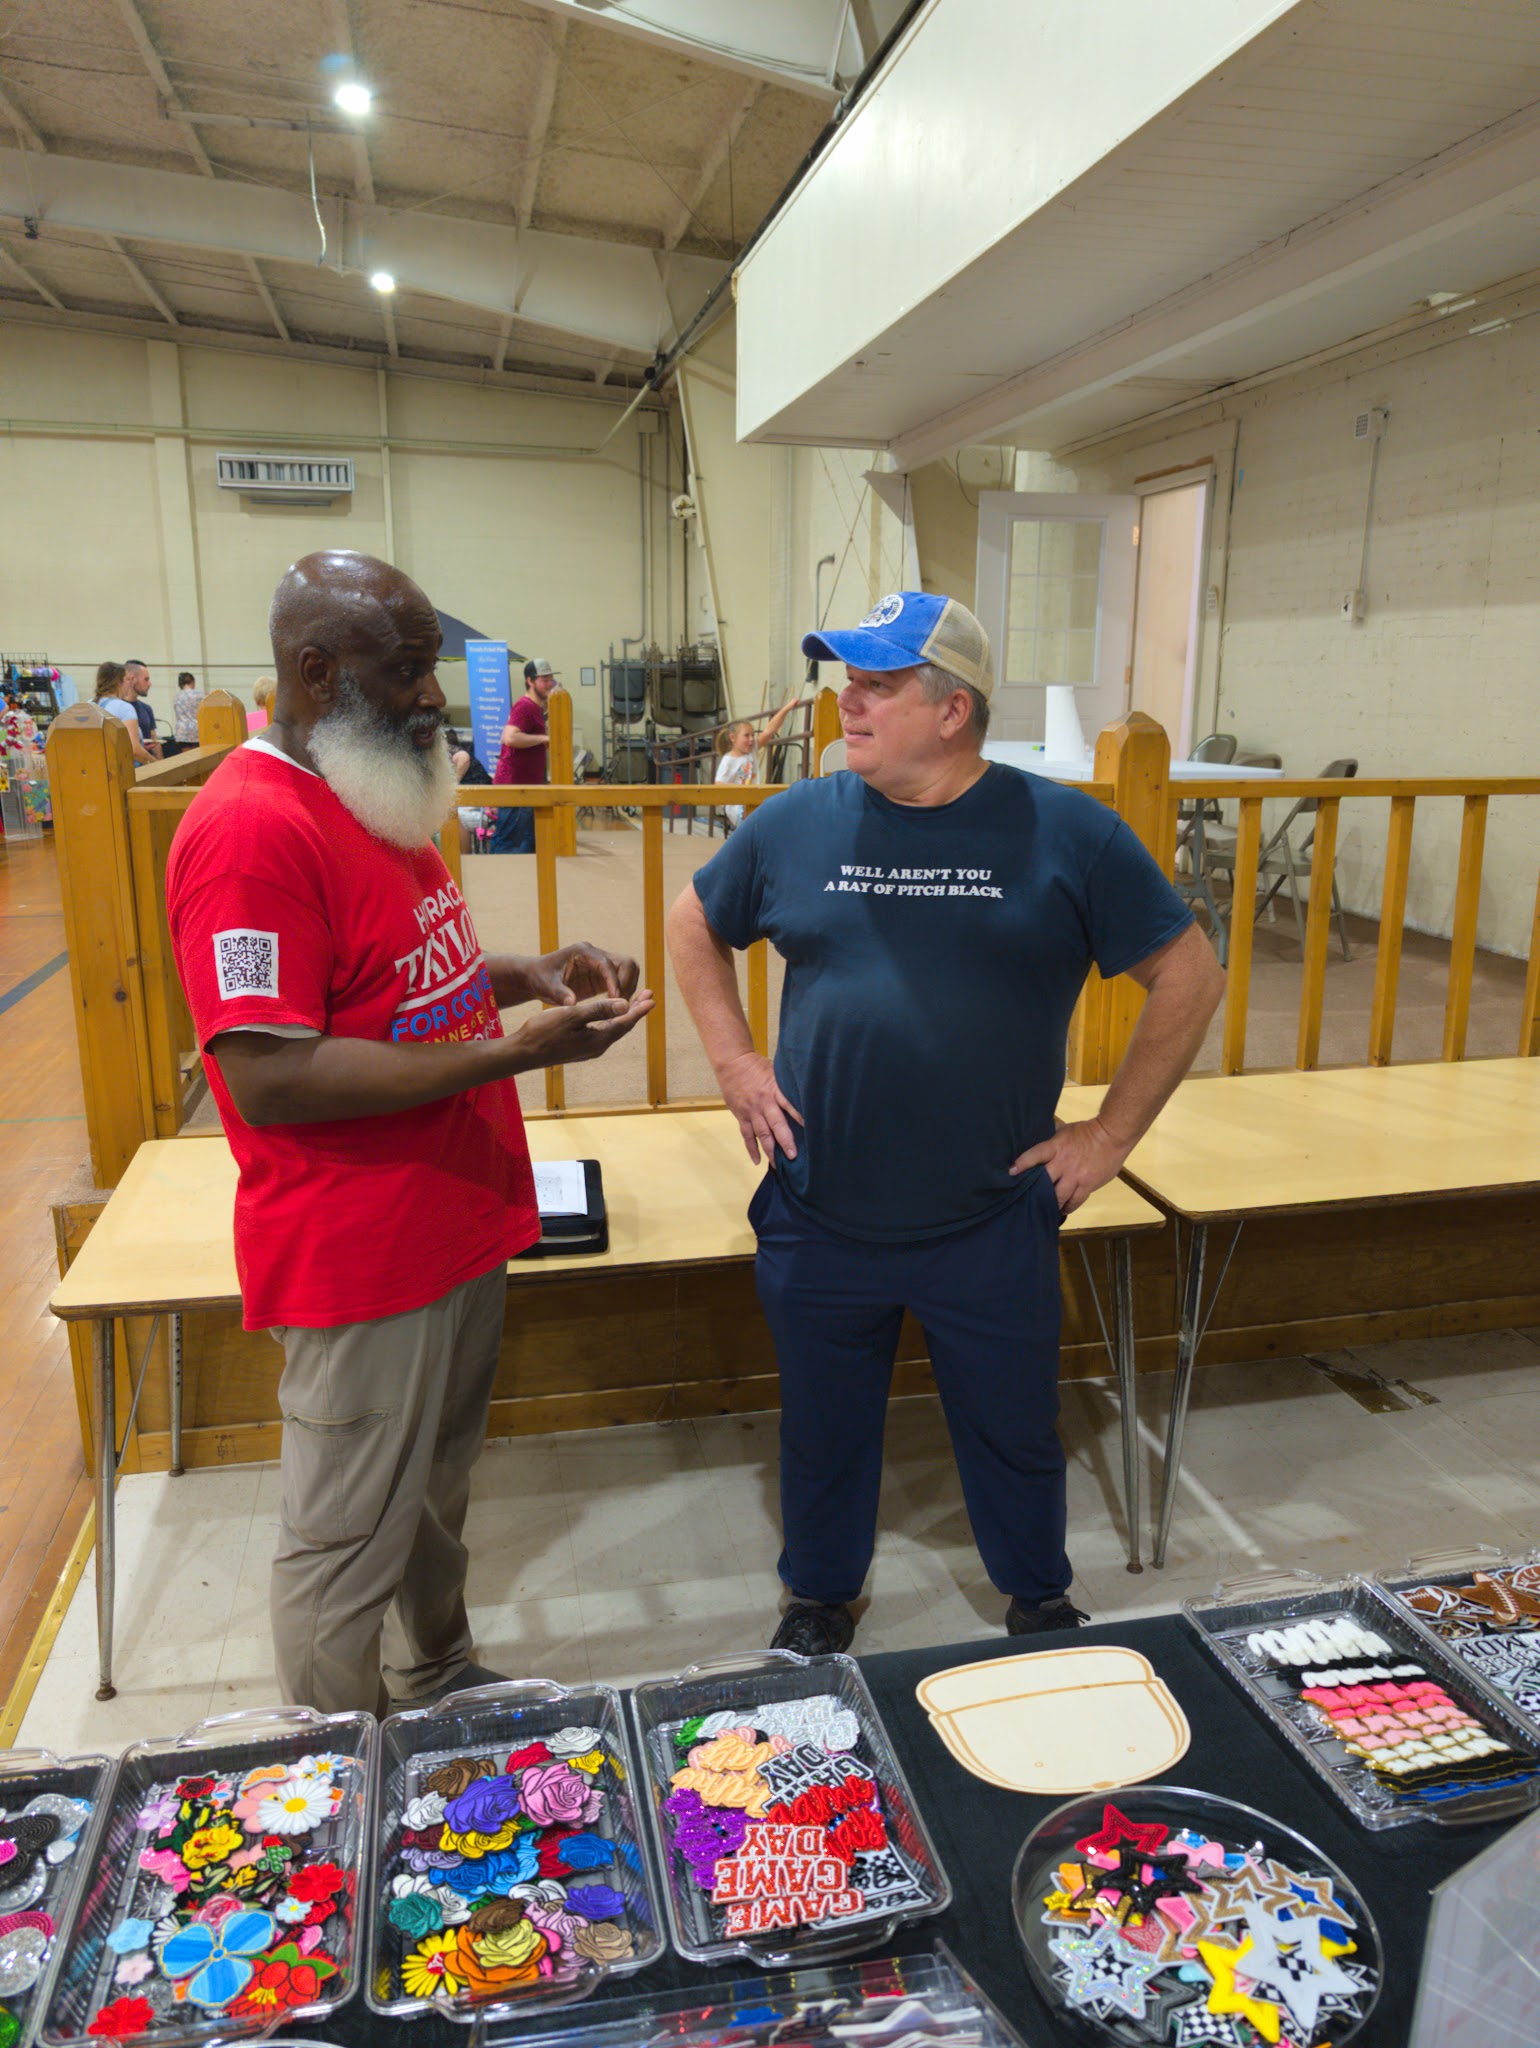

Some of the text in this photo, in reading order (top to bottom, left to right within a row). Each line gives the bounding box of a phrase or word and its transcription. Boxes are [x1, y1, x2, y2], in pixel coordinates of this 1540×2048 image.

[824, 881, 1004, 899] A RAY OF PITCH BLACK
[840, 865, 992, 881] WELL AREN'T YOU
[391, 1004, 450, 1043] FOR
[756, 1741, 833, 1795] DAY
[736, 1824, 825, 1859] DAY
[712, 1857, 846, 1903] GAME
[726, 1888, 864, 1937] GAME
